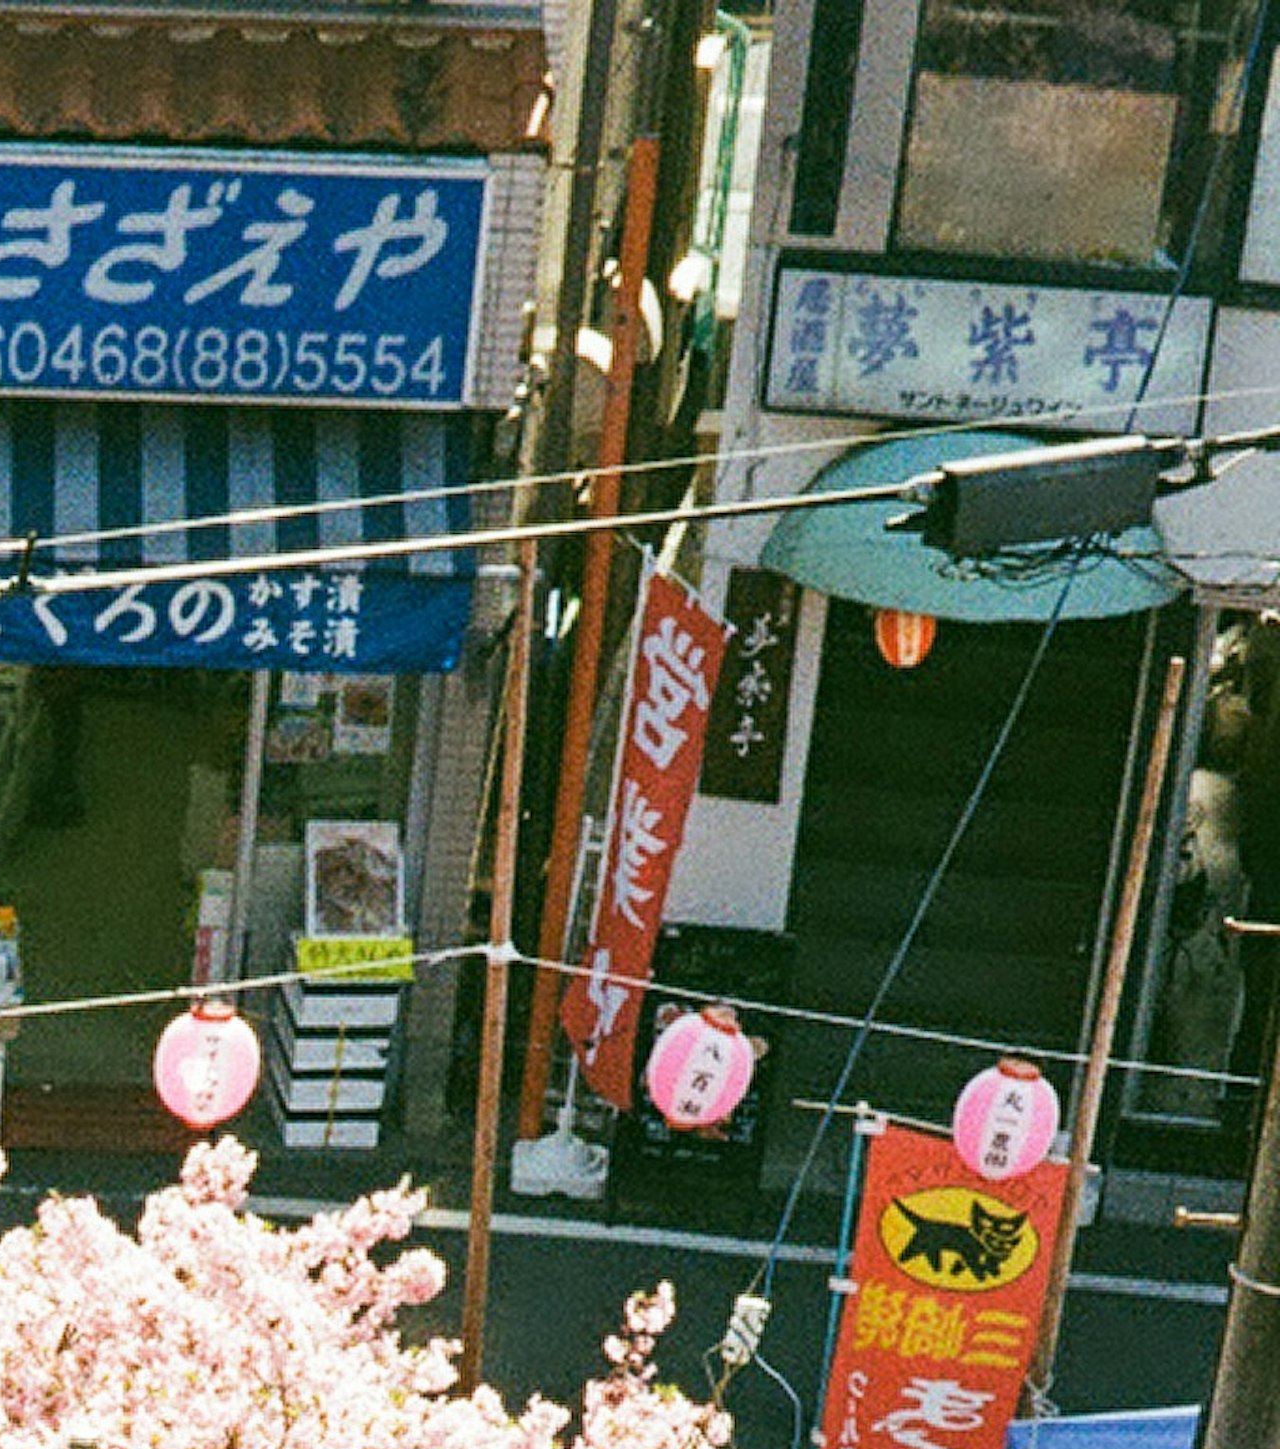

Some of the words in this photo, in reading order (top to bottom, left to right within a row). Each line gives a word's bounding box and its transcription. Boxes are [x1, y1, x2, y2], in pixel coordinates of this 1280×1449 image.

[8, 322, 446, 396] 0468(88)5554
[848, 293, 1161, 393] 夢紫亭
[246, 572, 365, 613] かす漬
[242, 619, 359, 660] みそ漬
